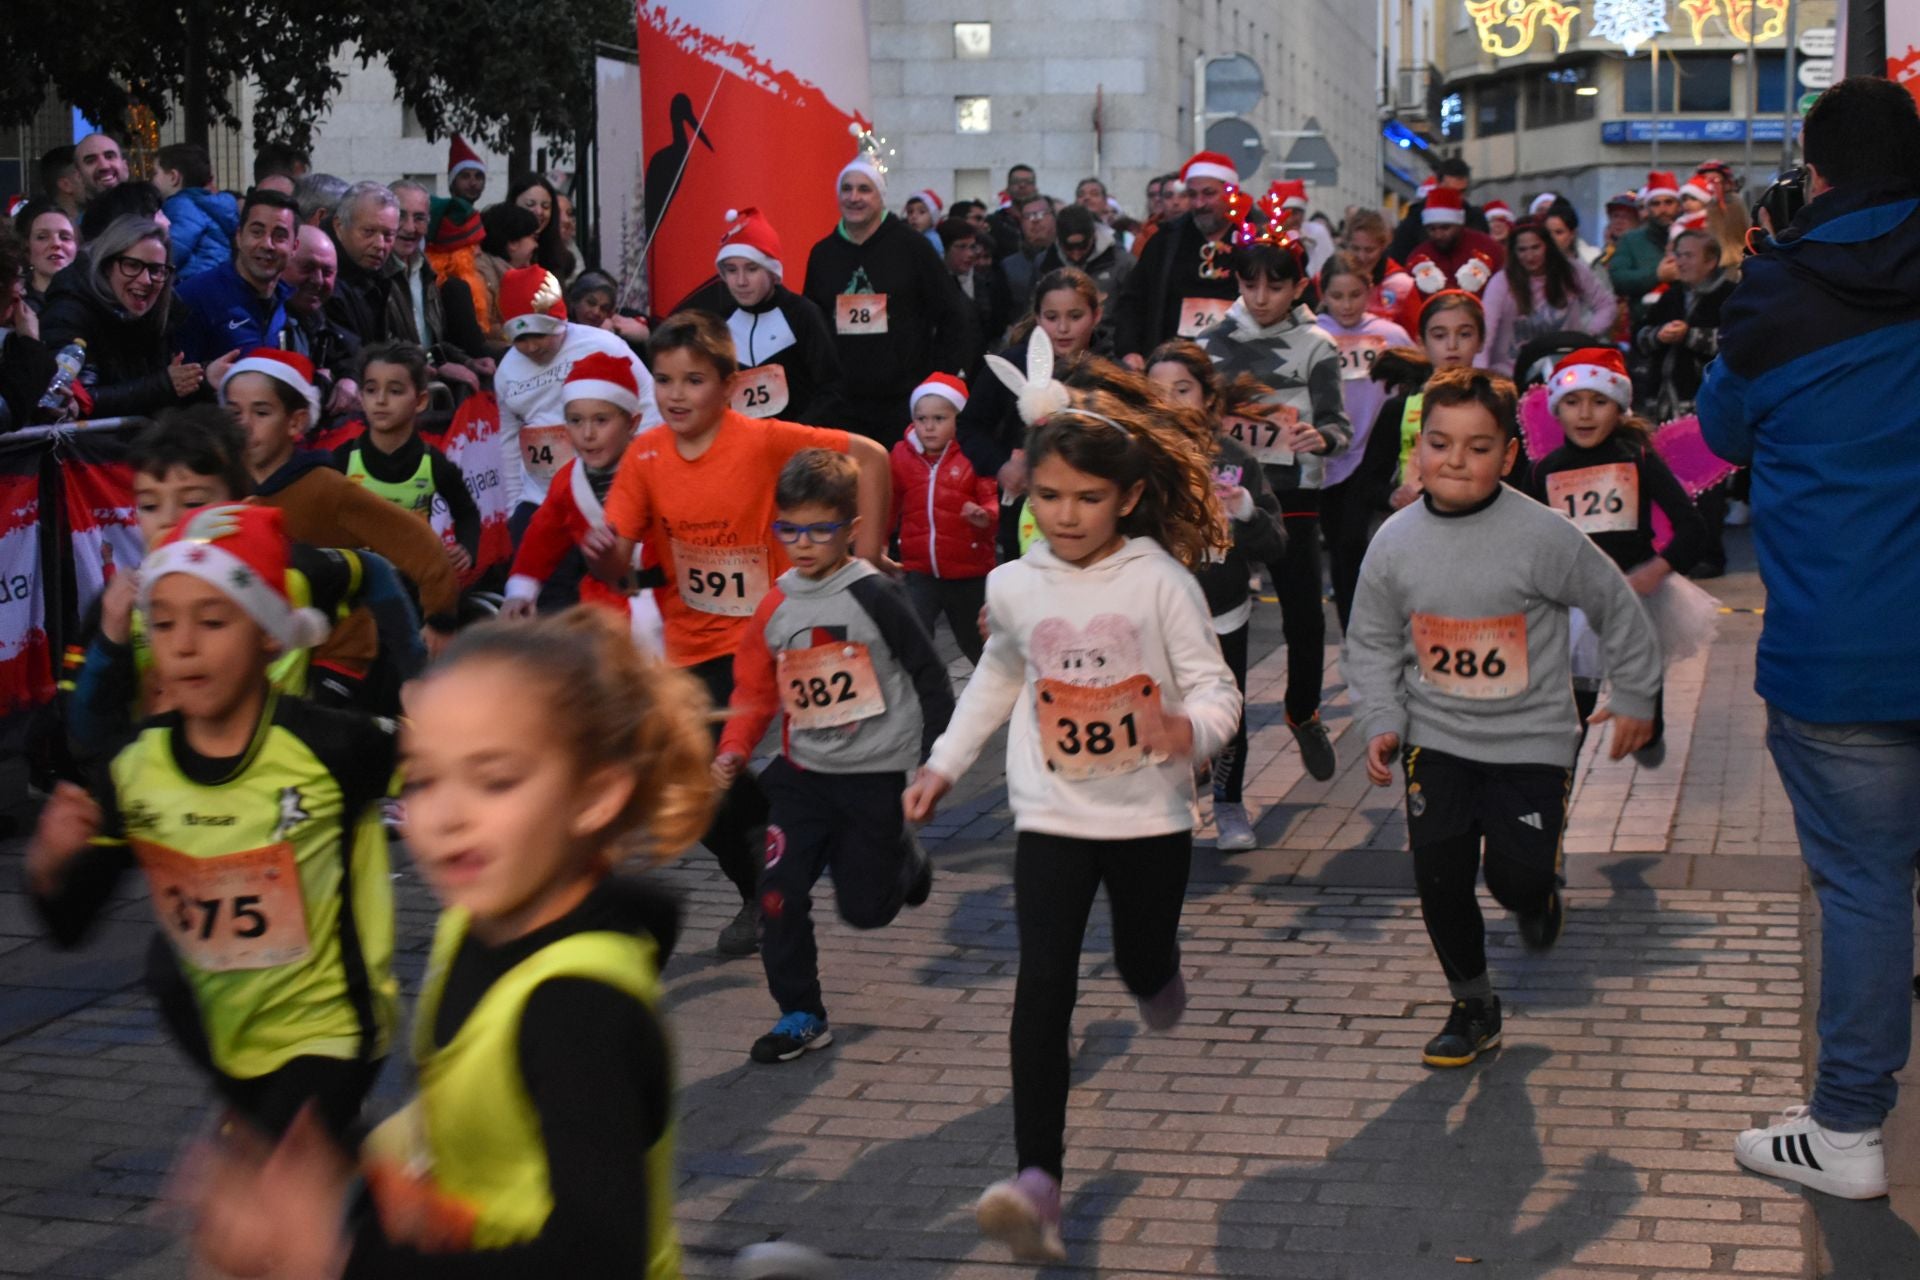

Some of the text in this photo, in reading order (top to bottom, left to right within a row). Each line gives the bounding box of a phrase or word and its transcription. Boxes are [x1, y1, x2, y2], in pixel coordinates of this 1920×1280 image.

[849, 308, 871, 324] 28
[743, 385, 770, 408] 25
[1230, 422, 1281, 448] 417
[527, 445, 554, 464] 24
[1563, 488, 1624, 519] 126
[688, 567, 745, 598] 591
[1429, 643, 1507, 679] 286
[790, 670, 858, 709] 382
[1056, 711, 1138, 756] 381
